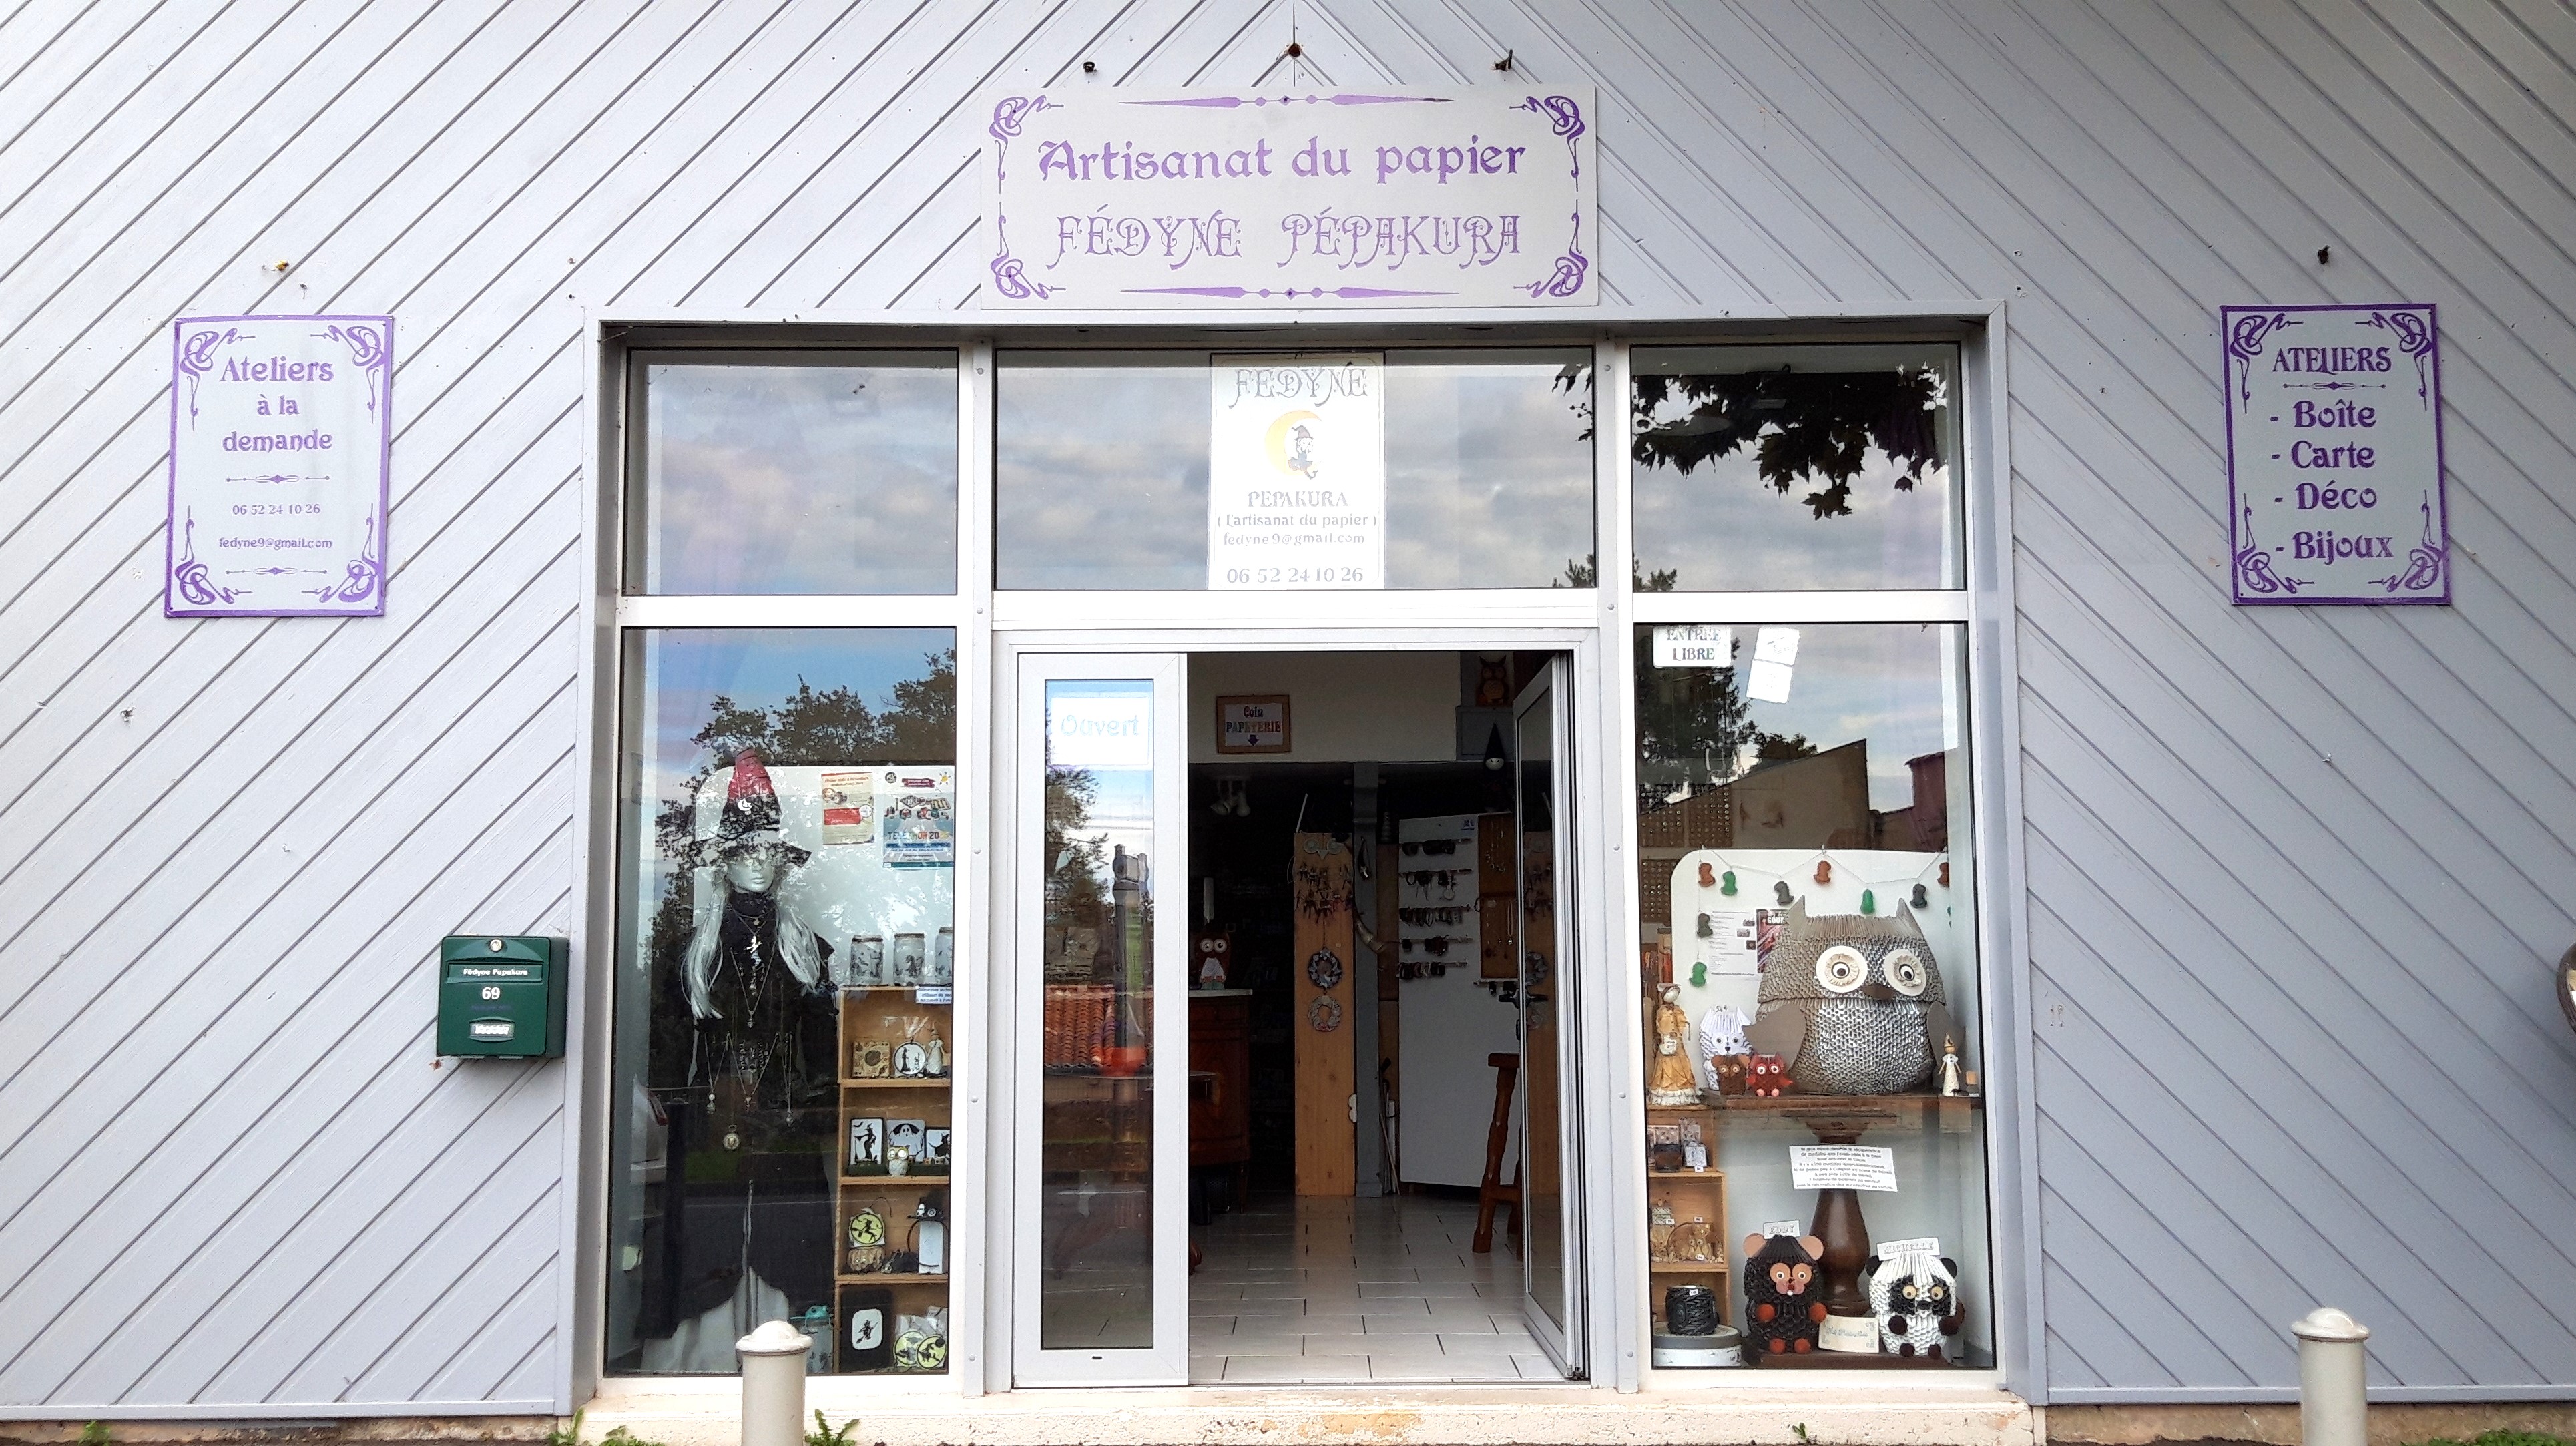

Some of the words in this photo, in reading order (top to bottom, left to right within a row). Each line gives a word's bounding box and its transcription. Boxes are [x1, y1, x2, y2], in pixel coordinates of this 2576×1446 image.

[1037, 138, 1273, 182] Artisanat
[1292, 135, 1352, 178] du
[1375, 134, 1527, 185] papier
[1045, 203, 1242, 271] FÉDYNE
[1276, 206, 1521, 271] PÉPAKURA
[220, 356, 334, 382] Ateliers
[2272, 346, 2392, 375] ATELIERS
[257, 393, 271, 416] à
[278, 395, 300, 415] la
[2292, 399, 2376, 428] Boîte
[222, 429, 332, 453] demande
[2291, 440, 2375, 469] Carte
[1247, 491, 1348, 507] PEPAKURA
[2295, 479, 2377, 510] Déco
[232, 505, 248, 515] 06
[251, 504, 265, 515] 52
[268, 504, 284, 515] 24
[288, 504, 302, 515] 10
[305, 503, 320, 514] 26
[1299, 513, 1317, 526] du
[1322, 513, 1368, 529] papier
[219, 537, 332, 551] fedyne9@gmail.com
[2292, 531, 2394, 565] Bijoux
[1226, 568, 1250, 584] 06
[1257, 567, 1281, 583] 52
[1288, 567, 1310, 583] 24
[1316, 567, 1335, 583] 10
[1340, 567, 1364, 582] 26
[1673, 647, 1715, 662] LIBRE
[1243, 706, 1264, 718] Coin
[1061, 714, 1139, 736] Ouvert
[1226, 720, 1282, 734] PAPETERIE
[482, 987, 500, 1000] 69
